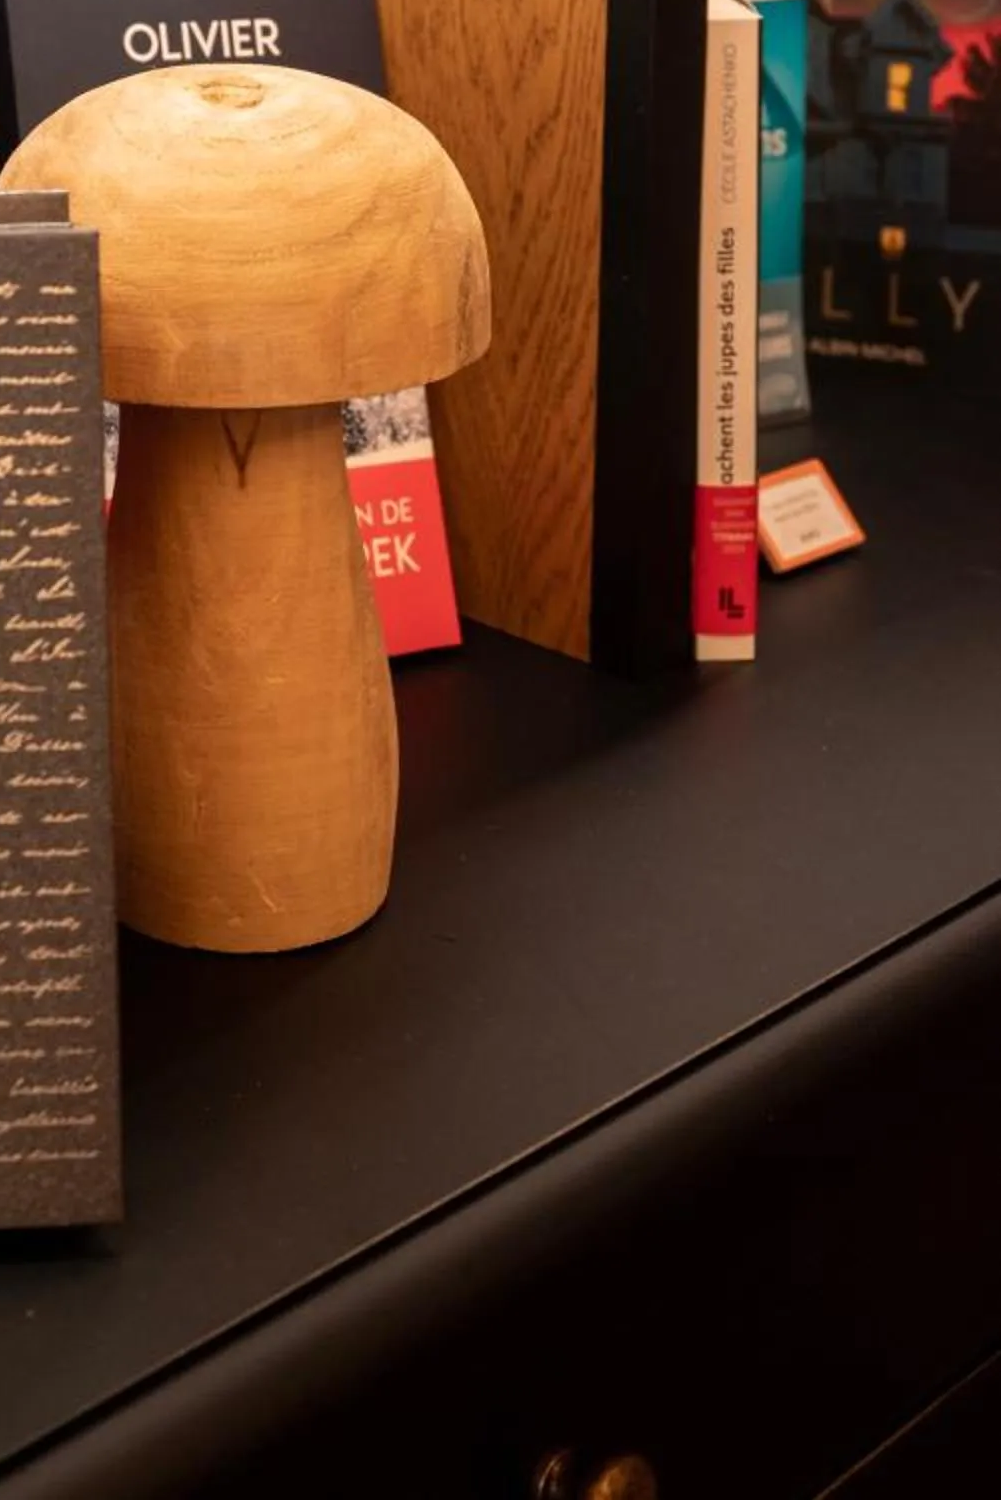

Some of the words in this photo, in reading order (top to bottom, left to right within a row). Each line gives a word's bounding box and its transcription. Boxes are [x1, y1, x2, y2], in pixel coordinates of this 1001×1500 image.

[123, 17, 281, 63] OLIVIER
[716, 227, 735, 275] filles
[717, 280, 735, 316] des
[717, 323, 738, 376] jupes
[717, 381, 734, 412] les
[717, 417, 735, 484] achent
[381, 497, 415, 526] DE
